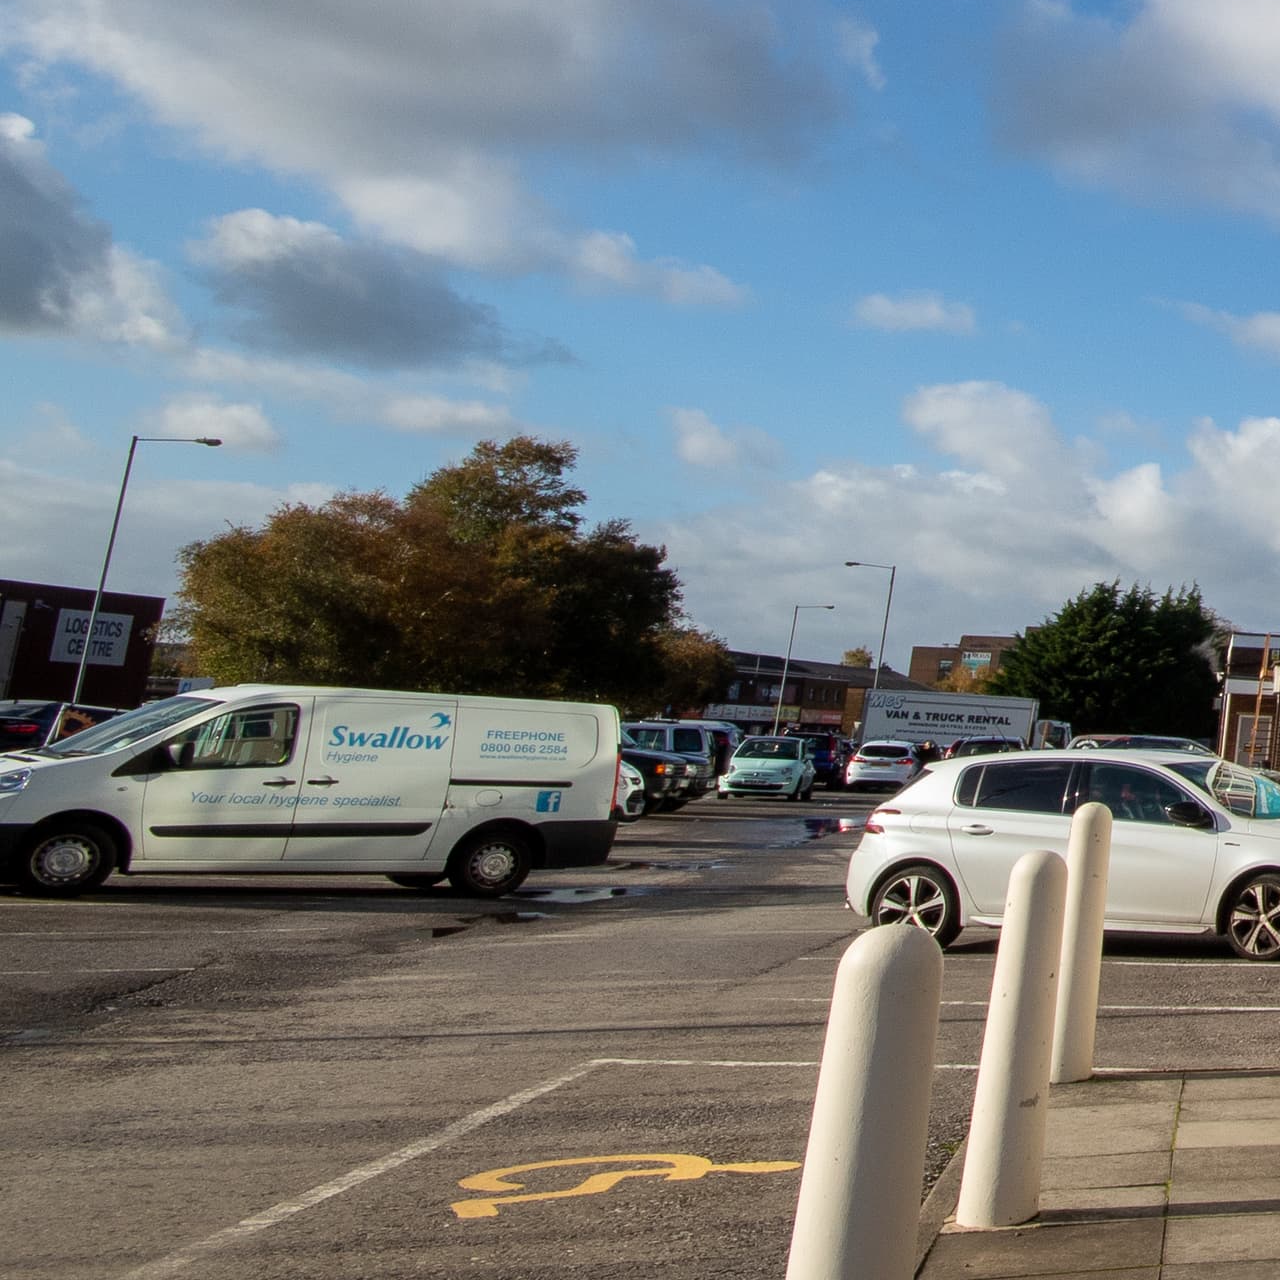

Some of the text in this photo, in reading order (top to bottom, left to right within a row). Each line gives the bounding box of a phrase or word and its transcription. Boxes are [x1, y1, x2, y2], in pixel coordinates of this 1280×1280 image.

[65, 617, 124, 638] LOGSTICS
[67, 638, 114, 657] CETRE
[885, 709, 1011, 726] VAN & TRUCK RENTAL
[328, 725, 449, 750] Swallow
[487, 730, 565, 742] FREEPHONE
[480, 743, 568, 754] 0800 066 2584
[326, 751, 378, 764] Hygiene
[191, 791, 225, 805] Your
[228, 792, 267, 806] local
[268, 793, 328, 808] hygiene
